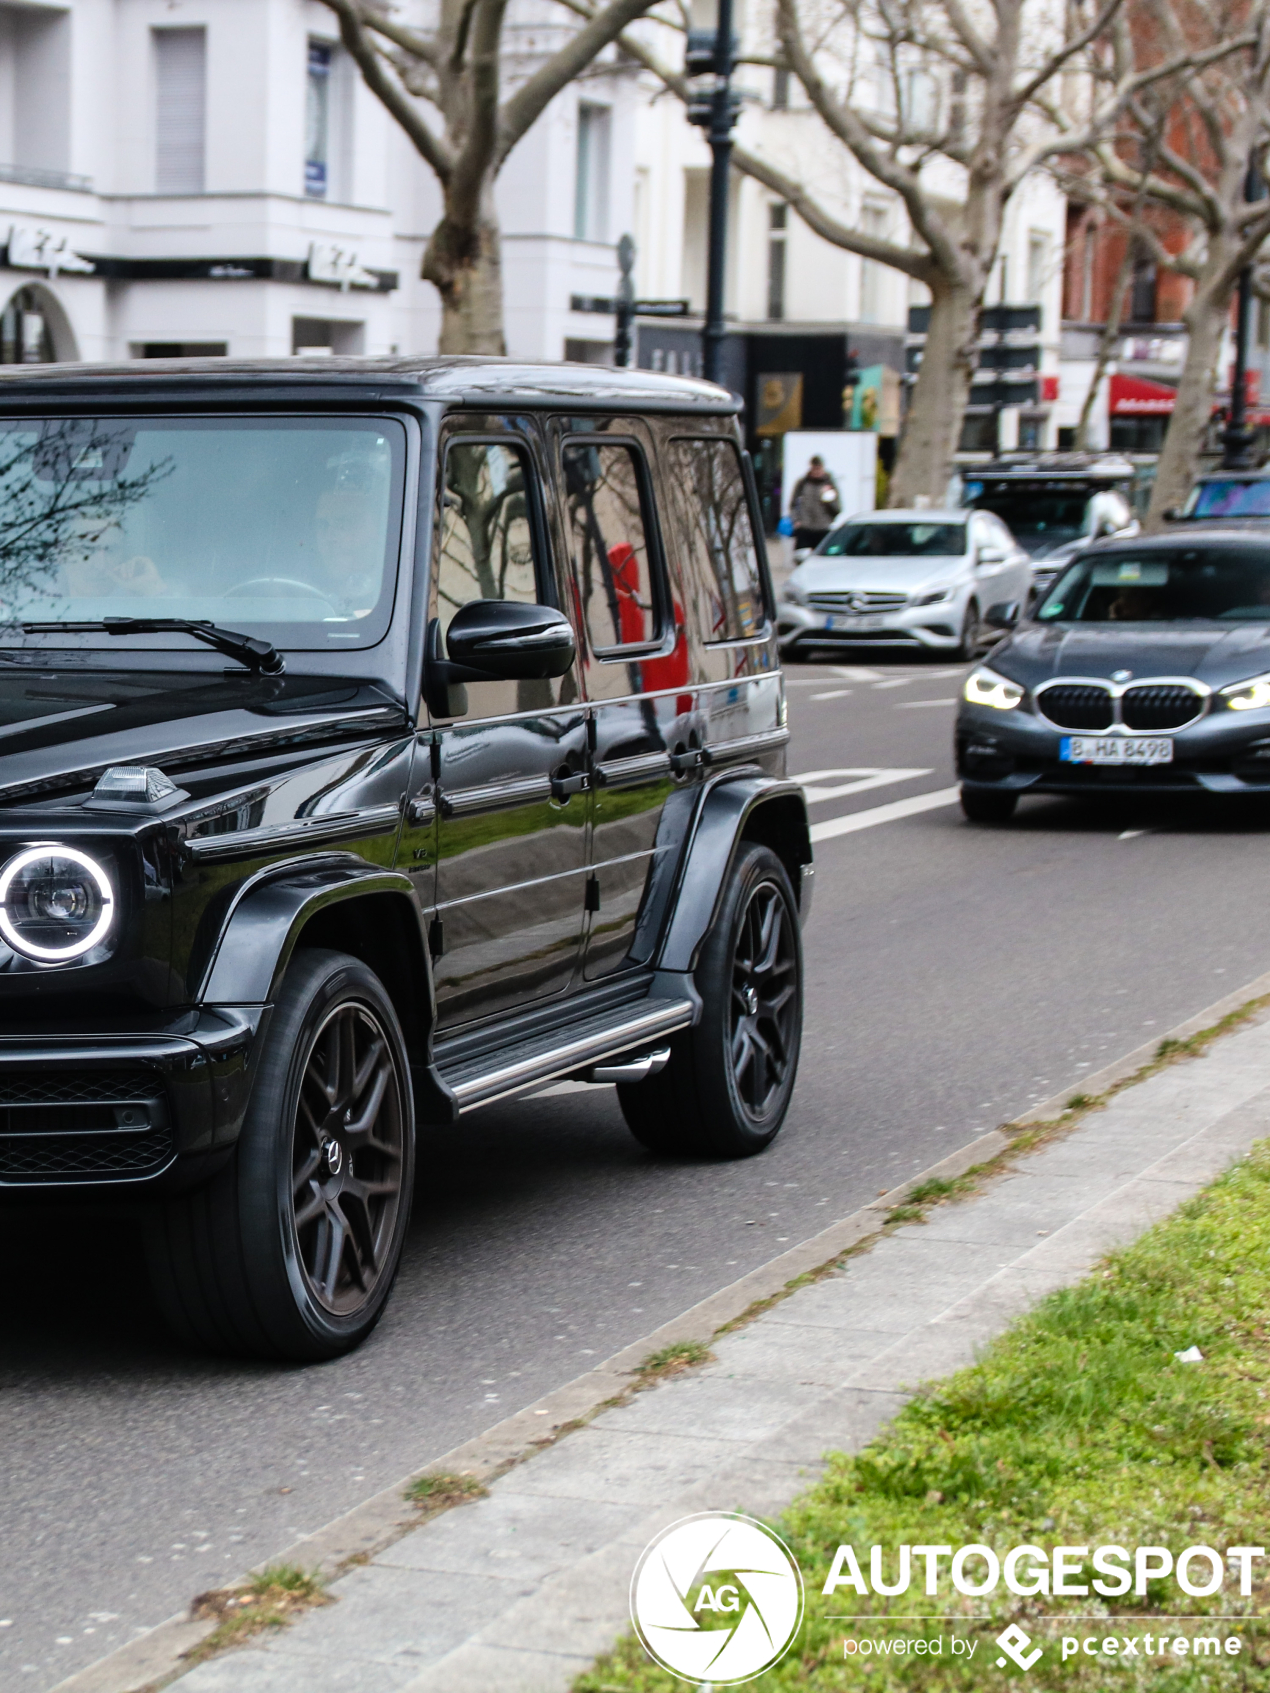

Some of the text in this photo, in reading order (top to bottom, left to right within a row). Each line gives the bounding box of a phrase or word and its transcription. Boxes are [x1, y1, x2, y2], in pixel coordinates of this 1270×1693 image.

[1071, 739, 1170, 759] B HA 8498
